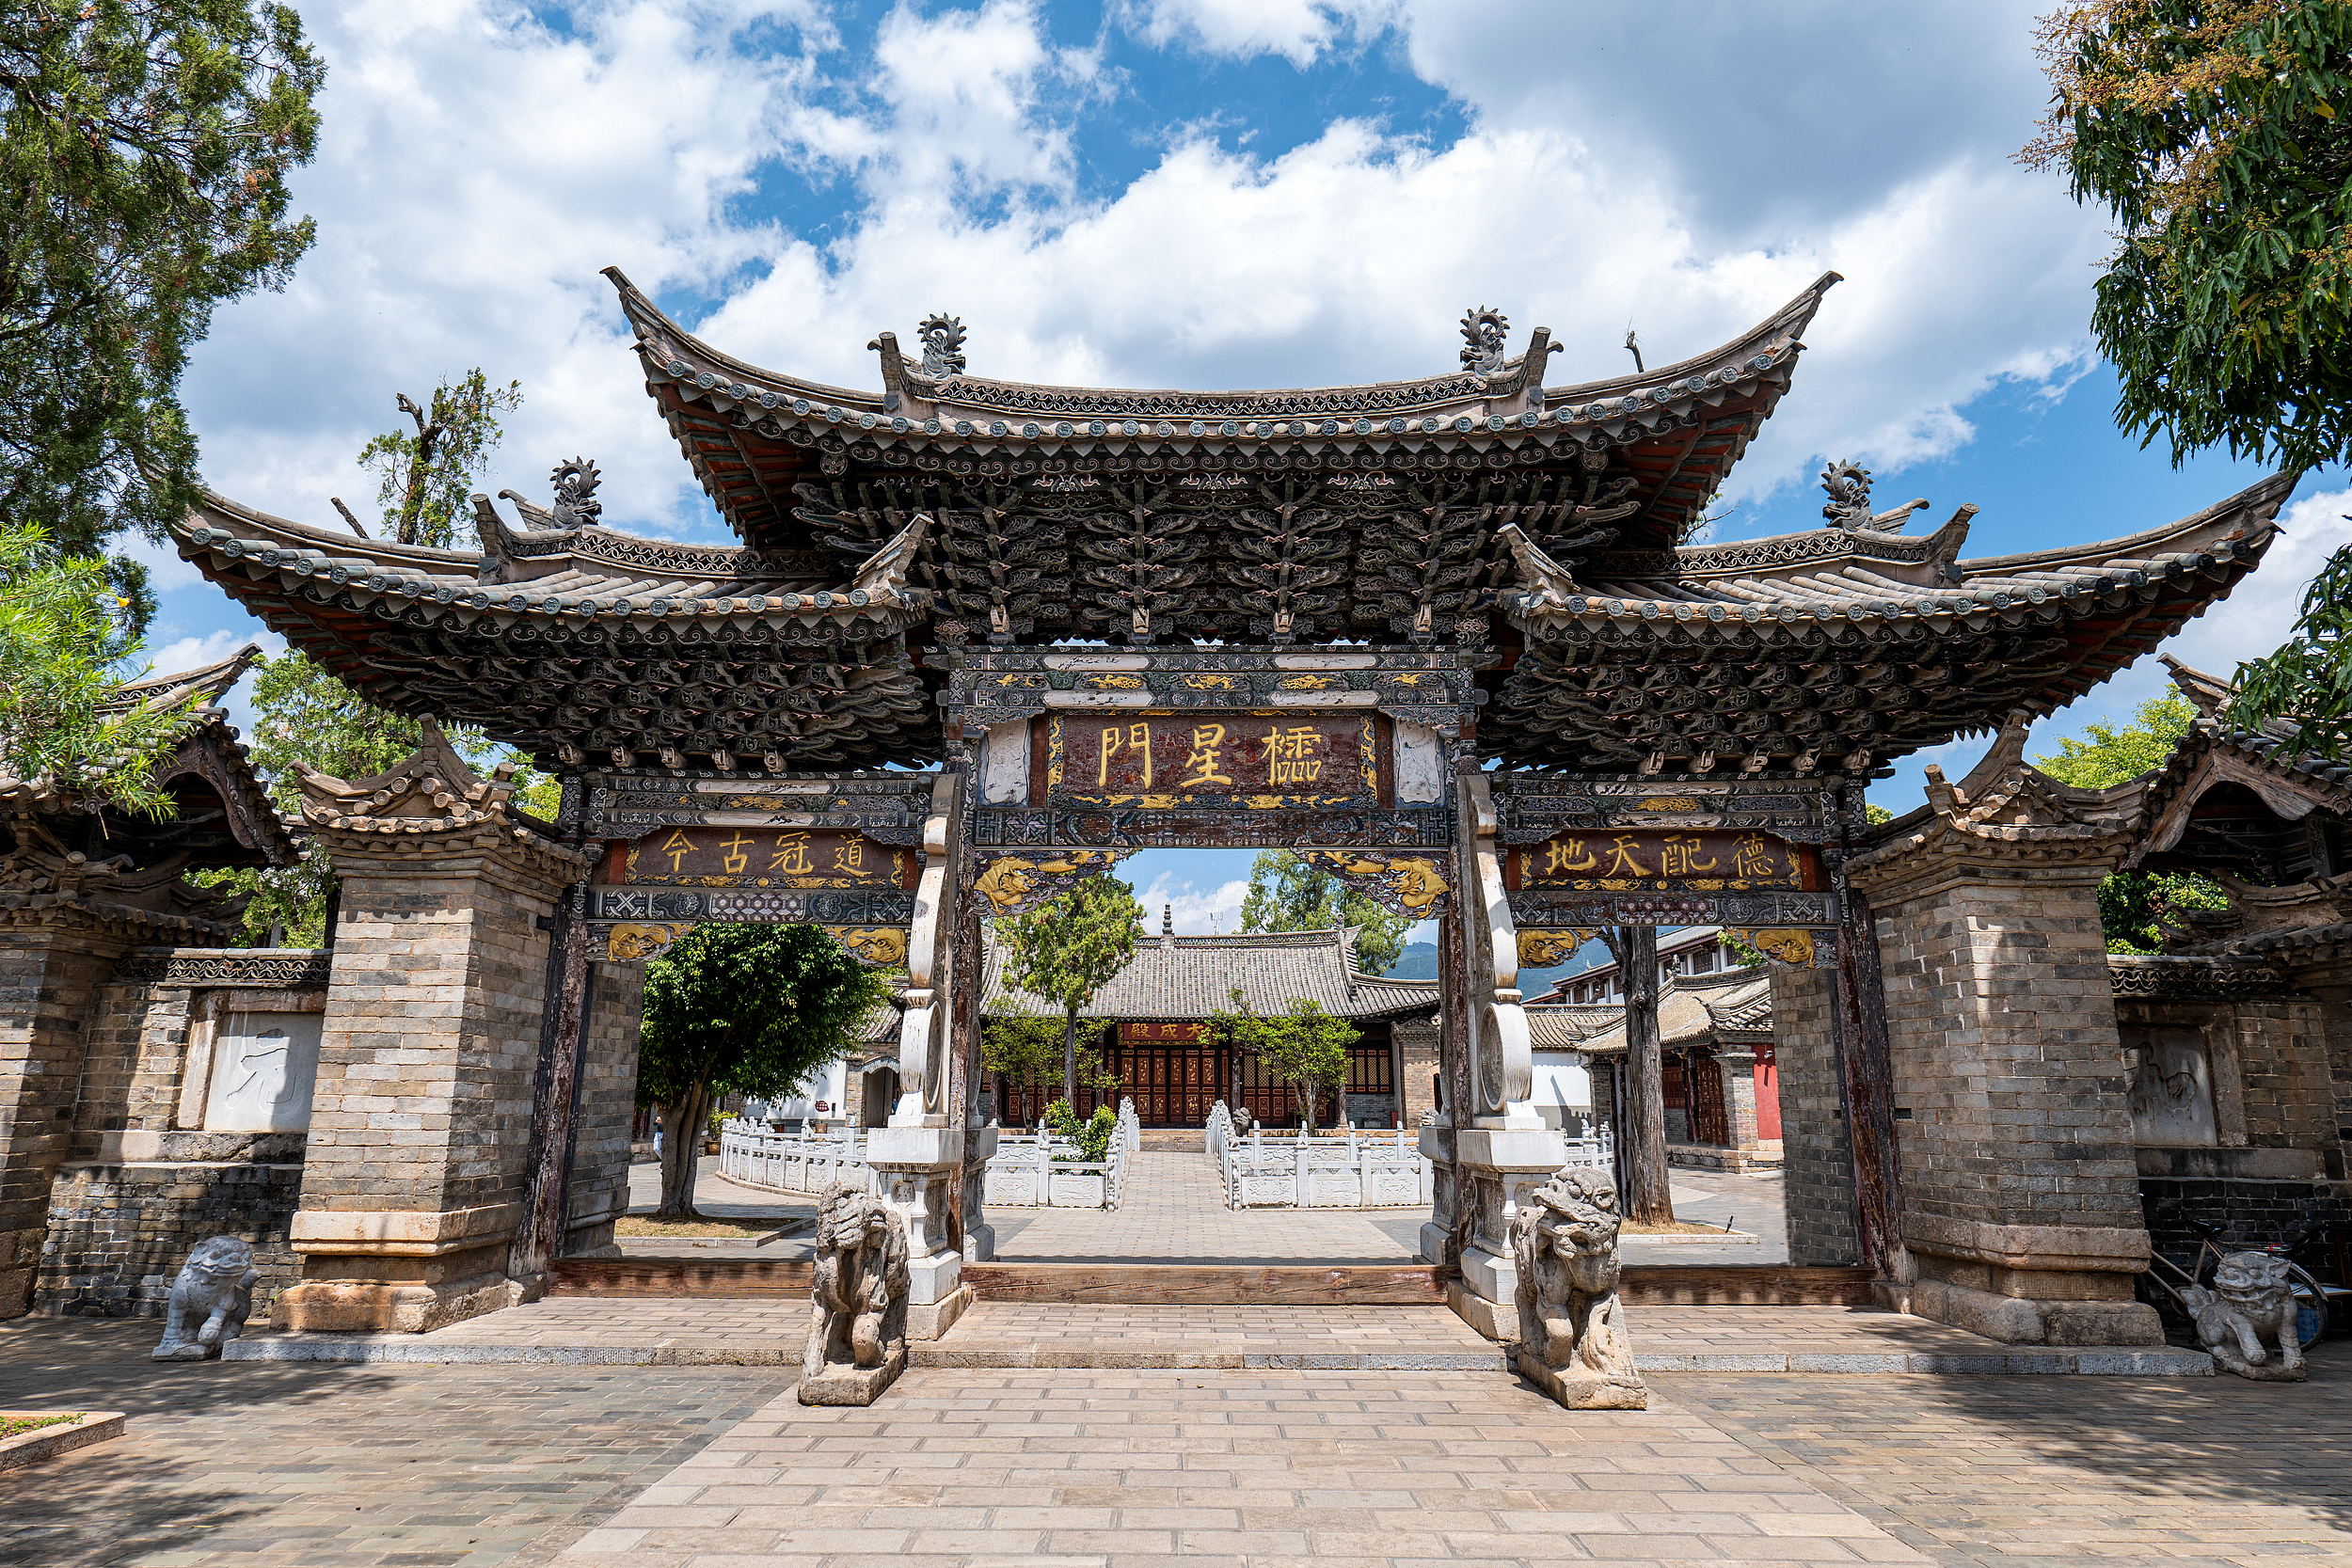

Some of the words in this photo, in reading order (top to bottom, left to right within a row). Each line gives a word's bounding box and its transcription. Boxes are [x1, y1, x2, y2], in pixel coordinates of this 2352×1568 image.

[661, 828, 873, 878] 道冠古今
[1544, 832, 1774, 877] 德配天地
[1130, 1022, 1204, 1038] 大成殿
